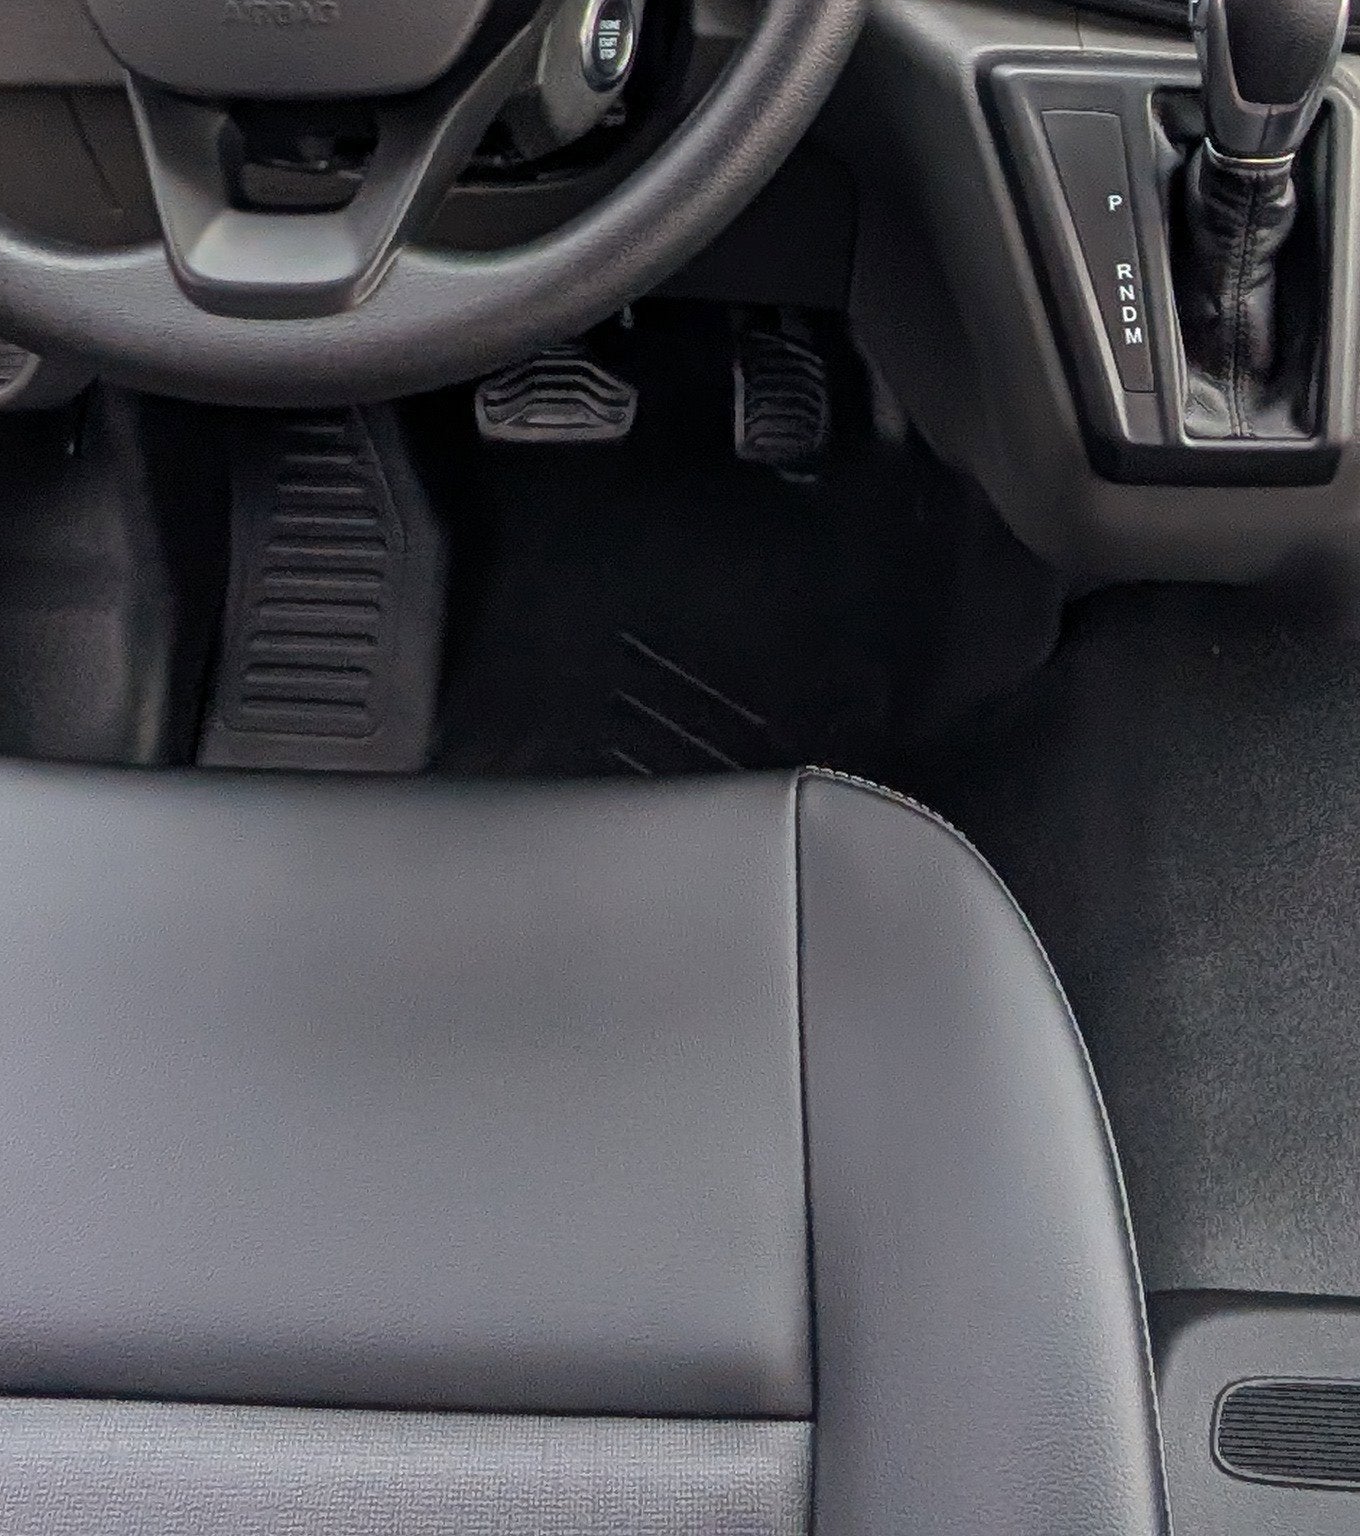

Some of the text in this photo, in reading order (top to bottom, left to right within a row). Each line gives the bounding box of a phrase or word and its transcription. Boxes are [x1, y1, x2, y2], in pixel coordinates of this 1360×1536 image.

[1107, 195, 1123, 212] P
[1117, 263, 1134, 280] R
[1119, 284, 1135, 300] N
[1121, 306, 1138, 322] D
[1124, 327, 1143, 343] M
